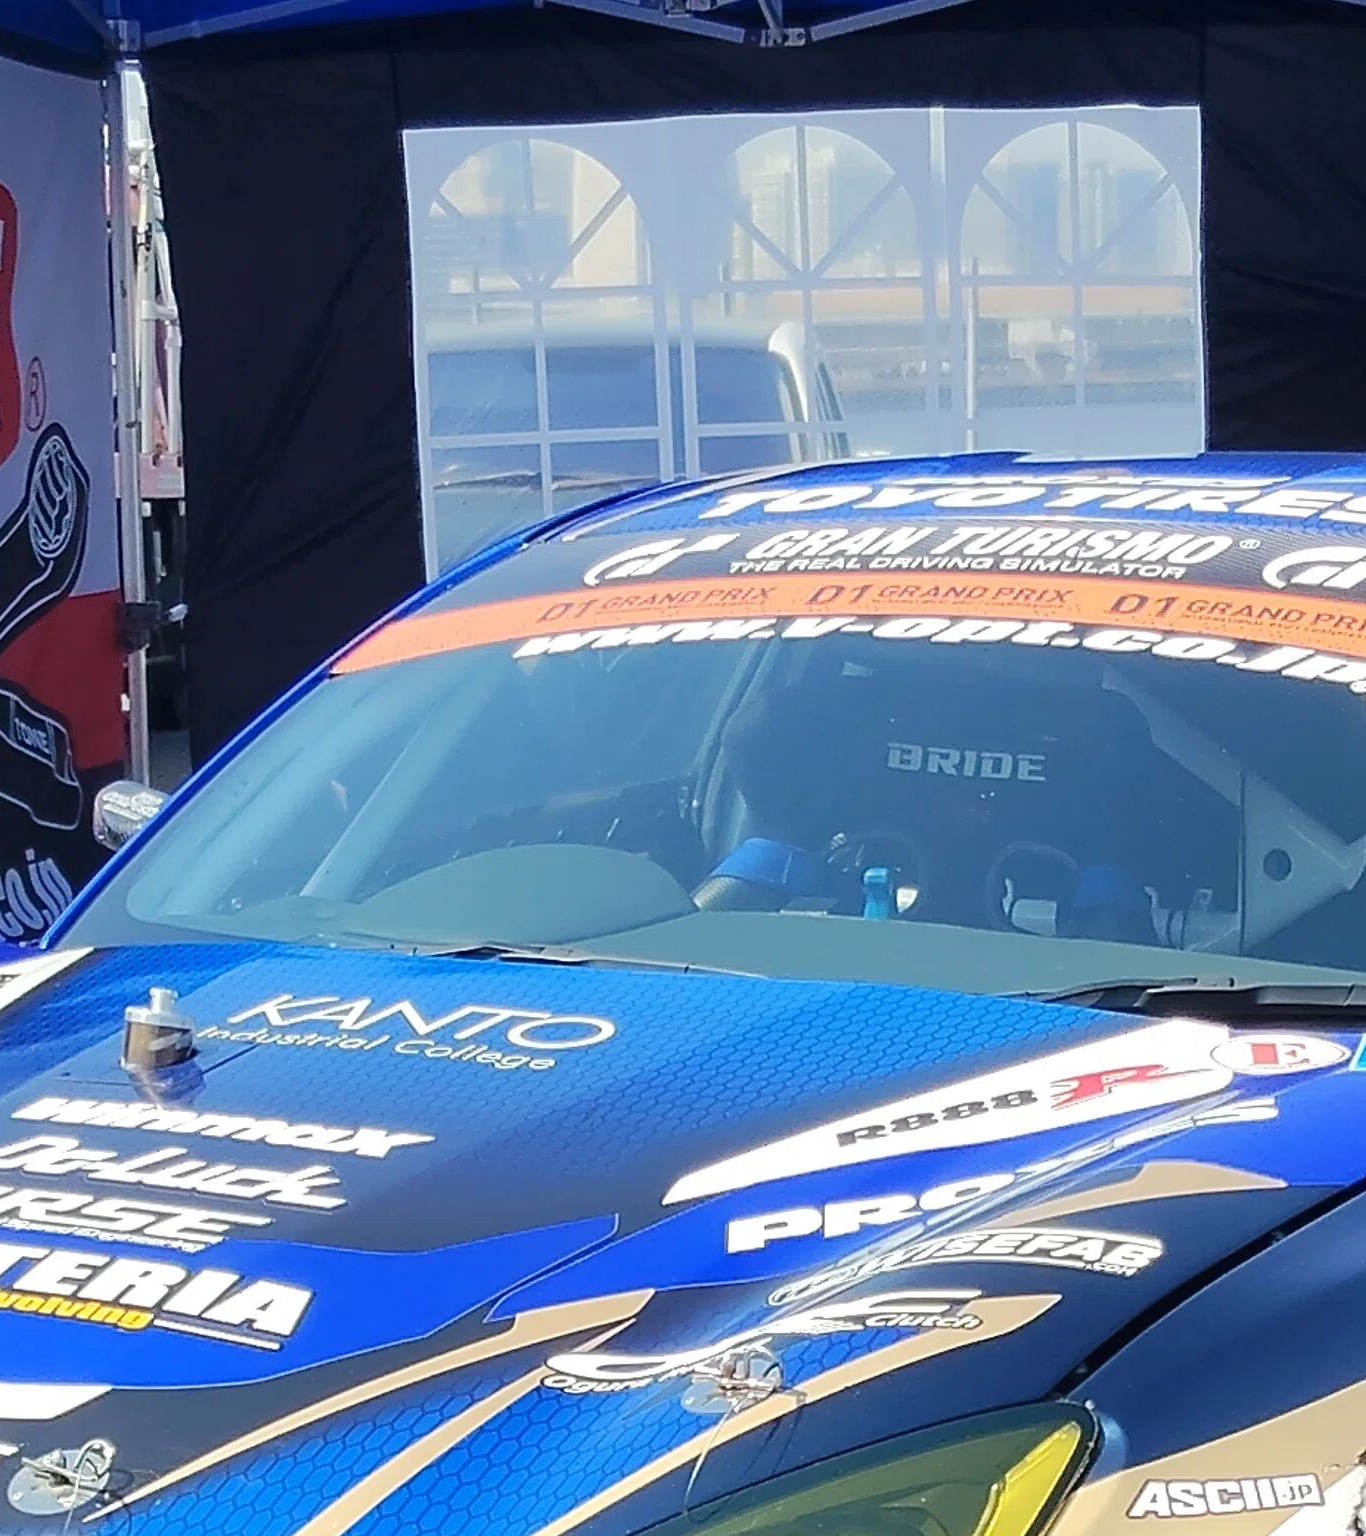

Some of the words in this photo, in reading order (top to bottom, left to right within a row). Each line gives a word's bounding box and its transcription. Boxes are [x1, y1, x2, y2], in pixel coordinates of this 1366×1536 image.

[698, 484, 1046, 519] TOYO
[746, 526, 938, 560] GRAN
[931, 526, 1235, 565] TURISMO
[730, 557, 784, 574] THE
[788, 557, 862, 571] REAL
[868, 556, 993, 571] DRIVING
[999, 557, 1186, 579] SIMULATOR
[599, 589, 703, 611] GRAND
[703, 586, 777, 603] PRIX
[878, 583, 987, 600] GRAND
[991, 586, 1074, 604] PRIX
[1186, 598, 1305, 625] GRAND
[887, 741, 1047, 783] BRIDE
[226, 992, 617, 1050] KANTO
[195, 1024, 391, 1052] Industrial
[394, 1037, 558, 1071] College
[865, 1311, 983, 1330] Clutch
